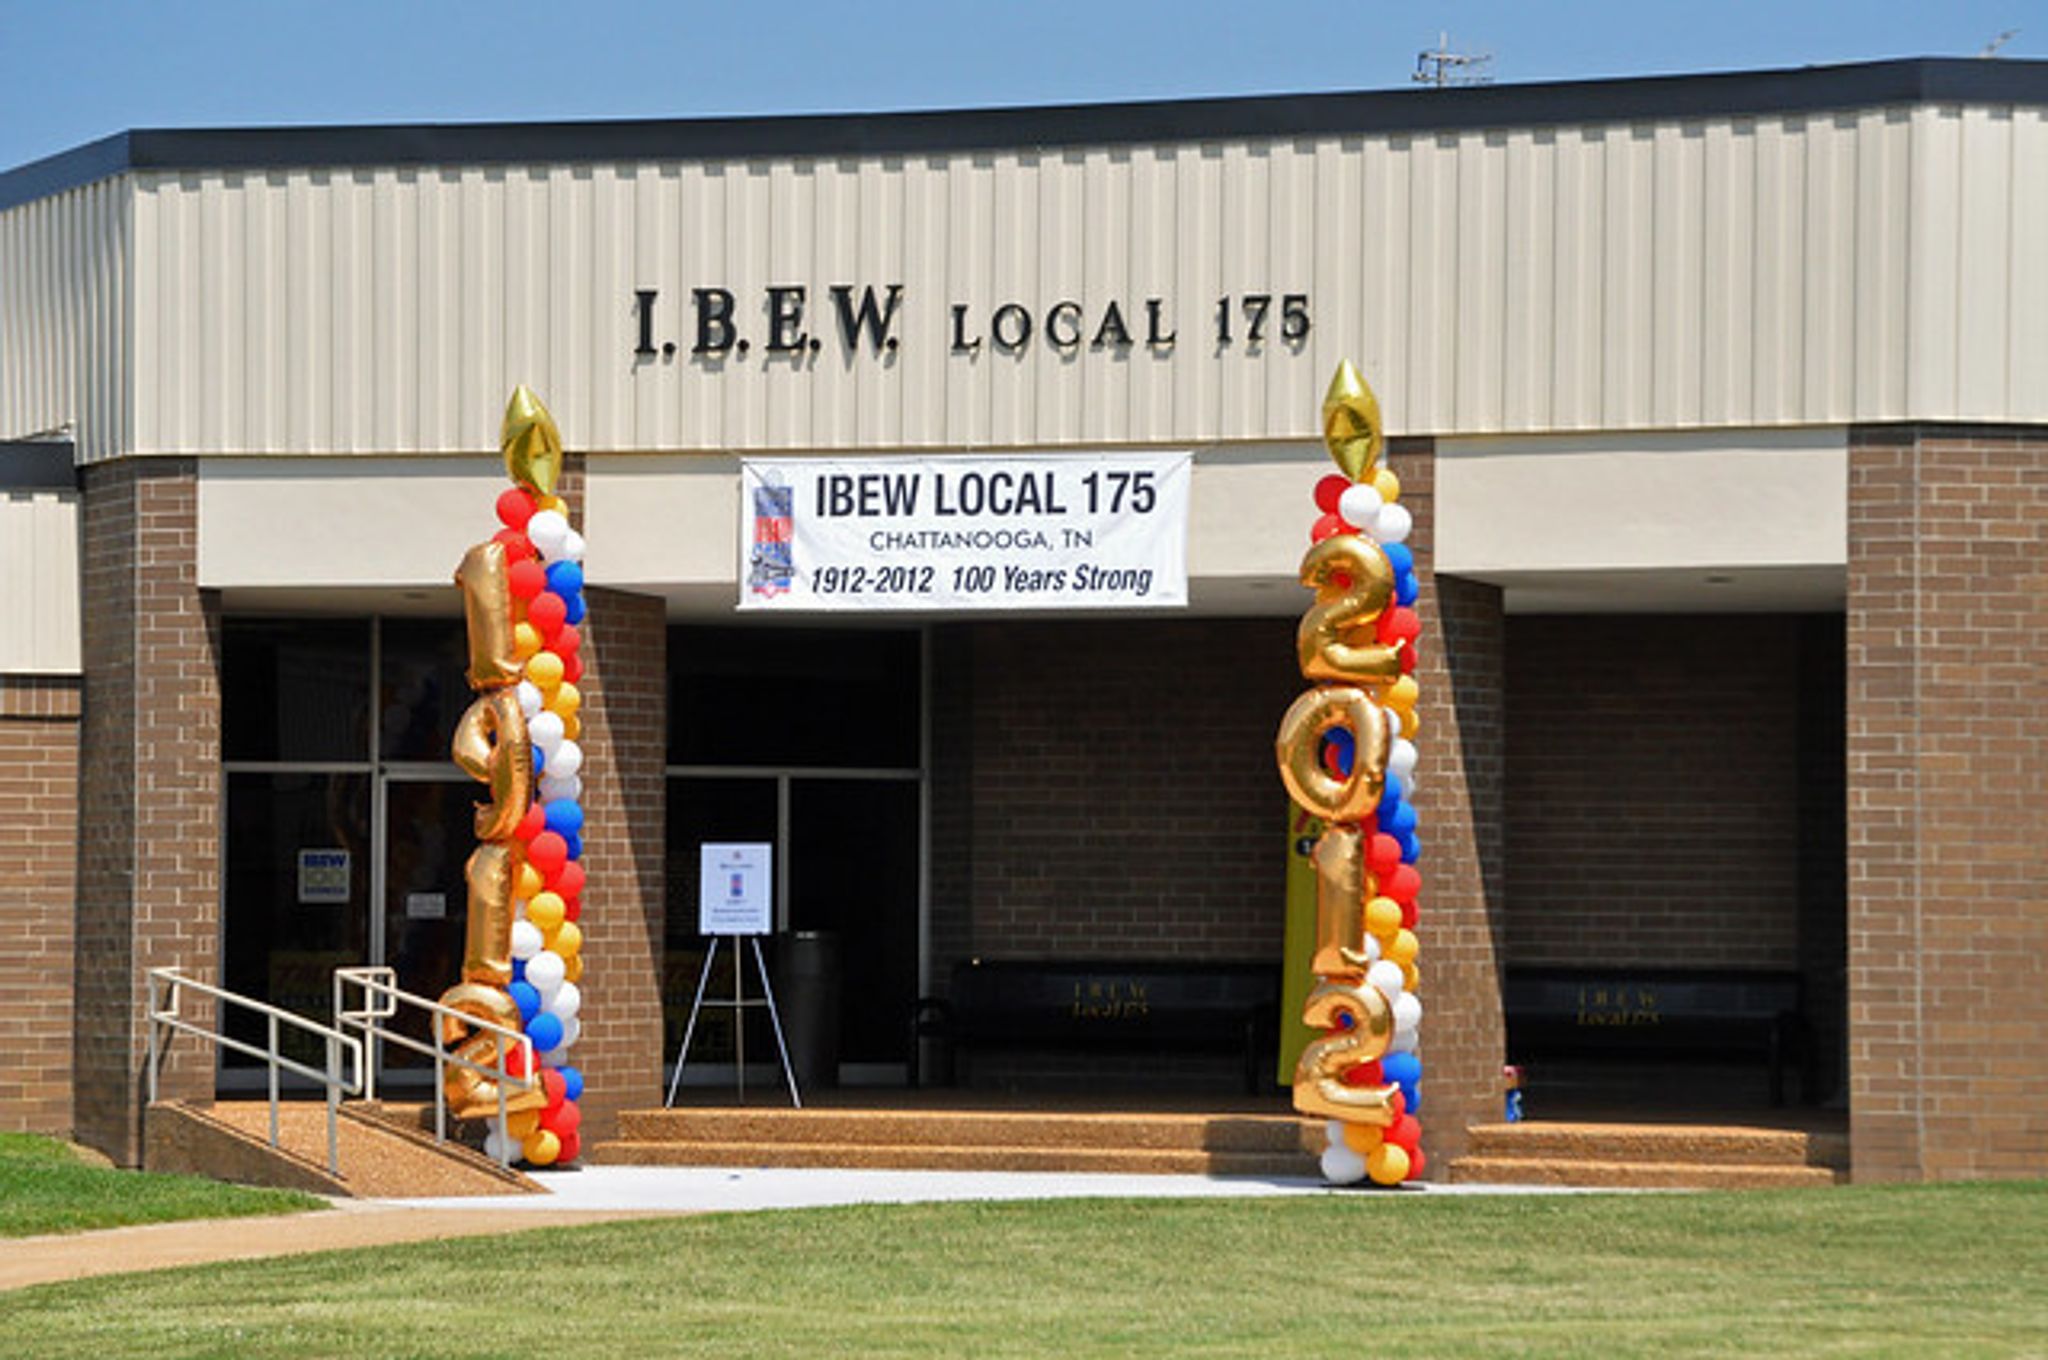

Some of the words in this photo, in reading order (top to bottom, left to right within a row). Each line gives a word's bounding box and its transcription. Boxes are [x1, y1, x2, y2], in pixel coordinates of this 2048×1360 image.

[951, 299, 1177, 349] LOCAL
[1217, 294, 1311, 346] 175
[815, 474, 921, 518] IBEW
[933, 471, 1067, 516] LOCAL
[1081, 470, 1157, 514] 175
[869, 530, 1055, 552] CHATTANOOGA,
[1062, 529, 1093, 549] TN
[811, 566, 933, 593] 1912-2012
[952, 567, 996, 592] 100
[1001, 565, 1066, 592] Years
[1071, 563, 1153, 596] Strong
